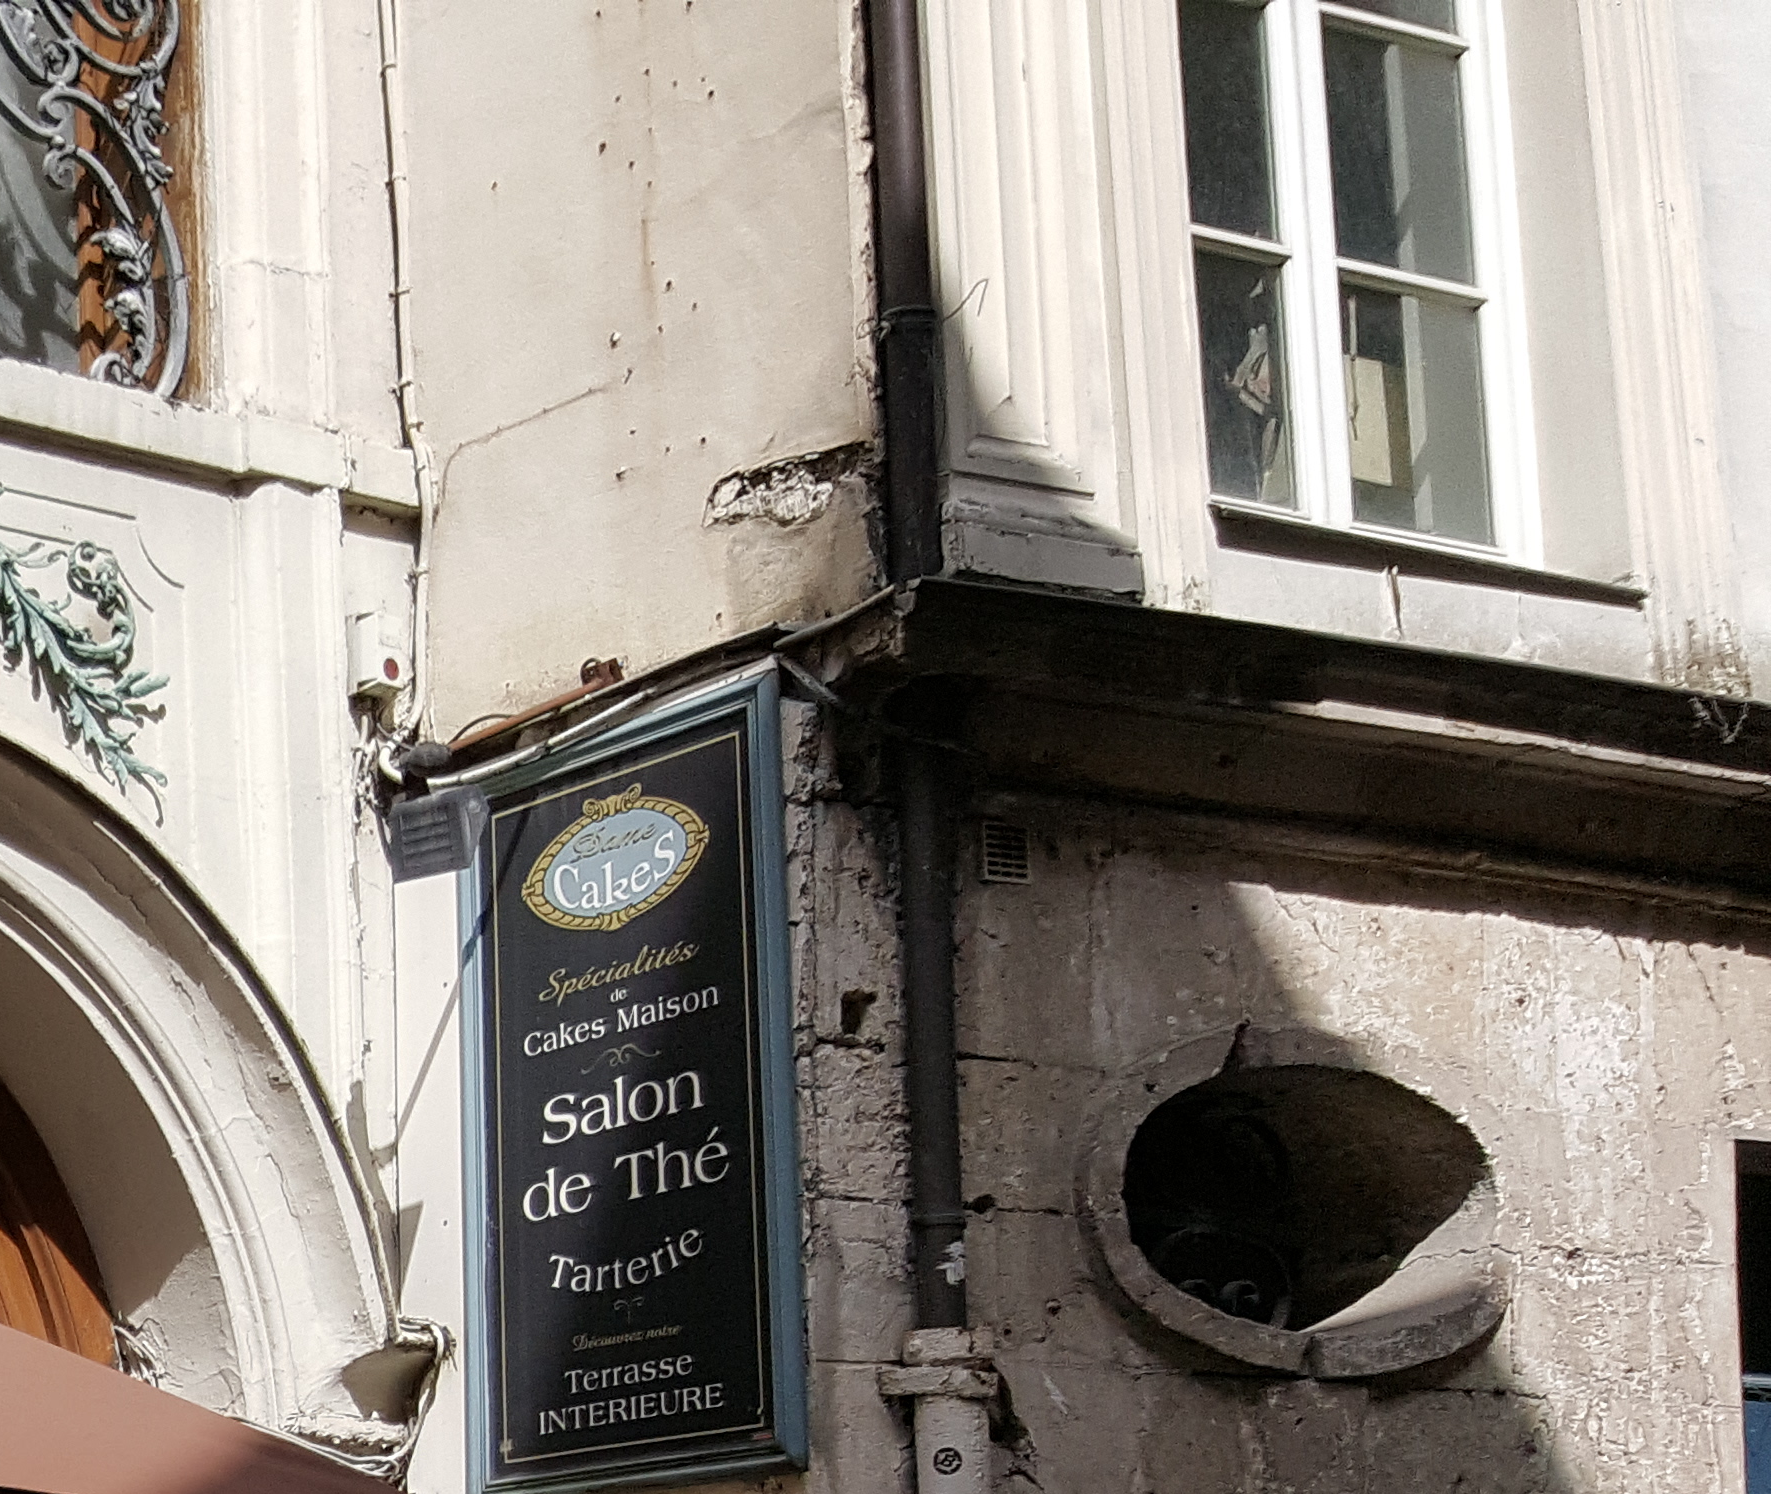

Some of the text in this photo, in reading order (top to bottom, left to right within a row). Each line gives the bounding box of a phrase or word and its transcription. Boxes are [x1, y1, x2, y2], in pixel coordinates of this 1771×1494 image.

[569, 822, 658, 864] Dame
[539, 938, 701, 1006] Spécialités
[609, 986, 629, 1003] de
[523, 986, 720, 1058] Cakes Maison
[540, 1069, 706, 1146] Salon
[522, 1126, 731, 1223] de Thé
[548, 1226, 703, 1294] Tarterie
[564, 1353, 694, 1396] Terrasse
[538, 1382, 726, 1436] INTERIEURE
